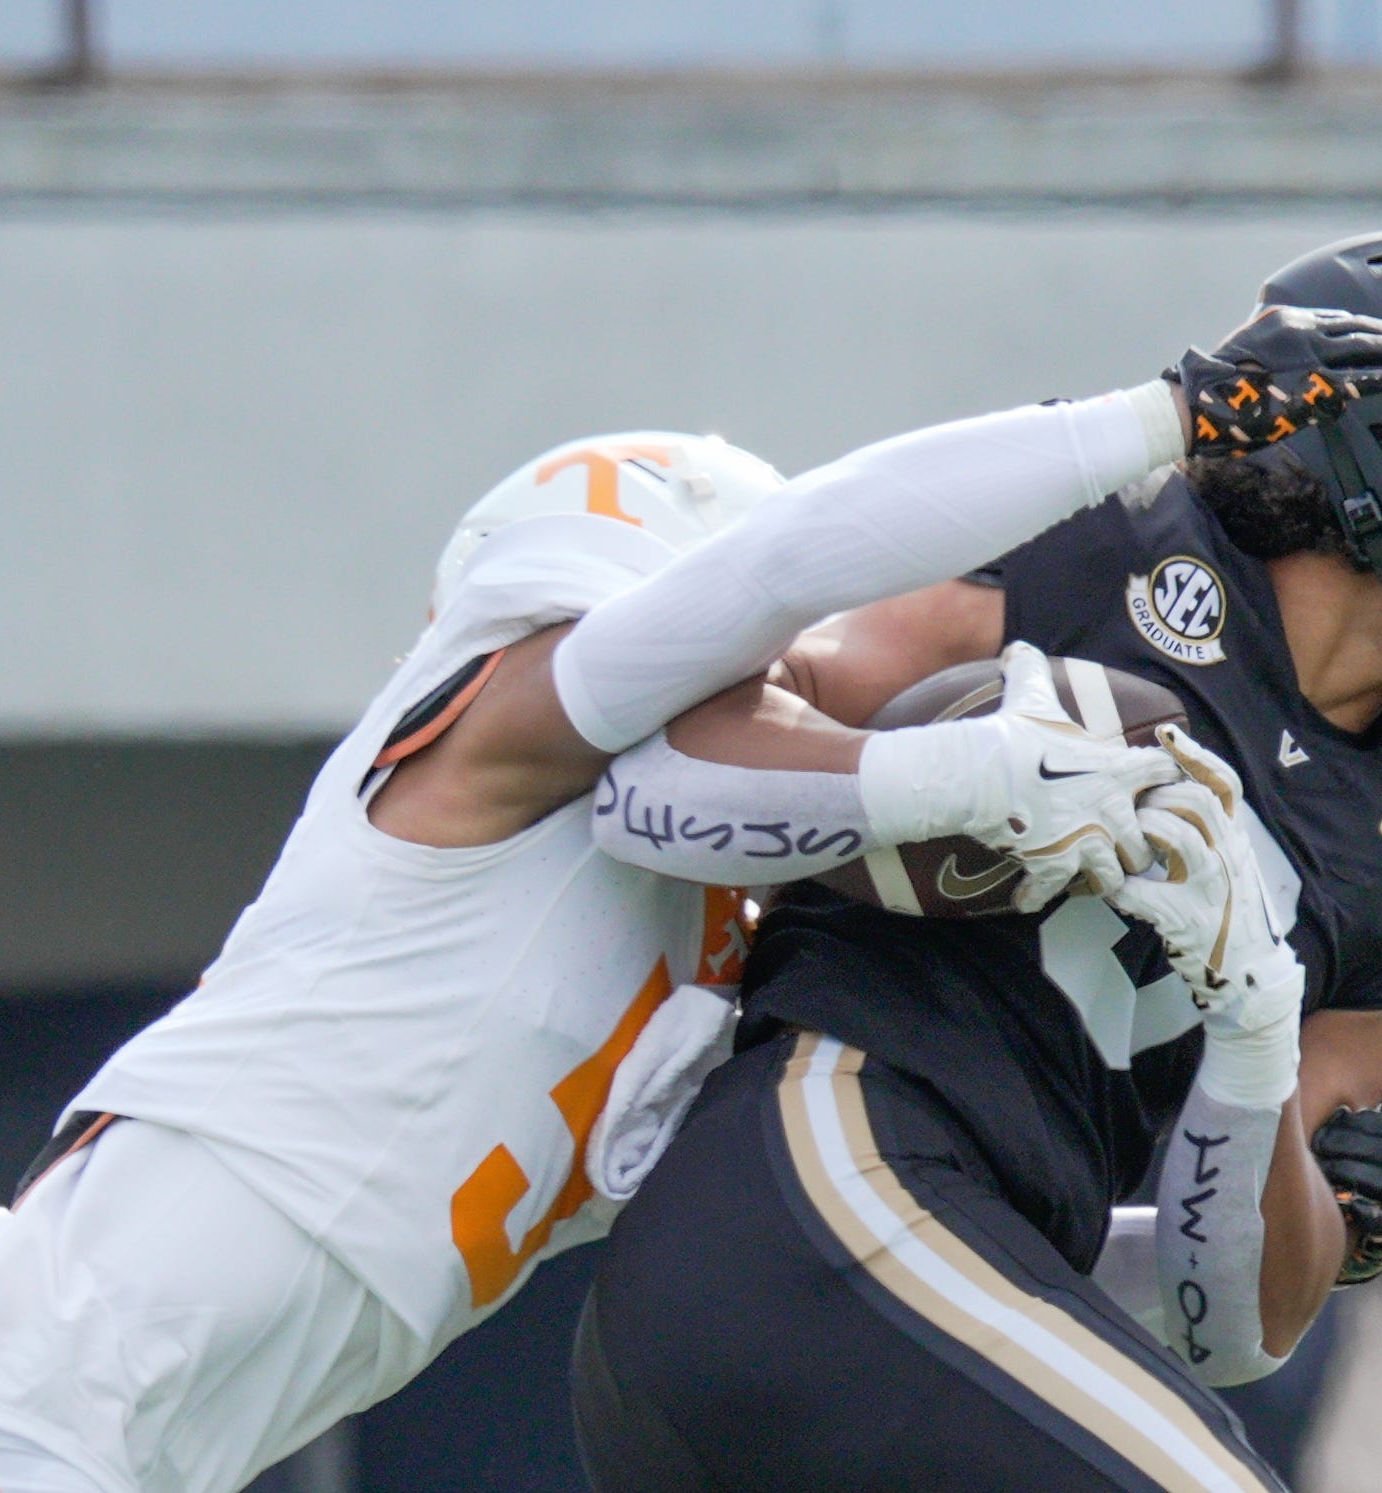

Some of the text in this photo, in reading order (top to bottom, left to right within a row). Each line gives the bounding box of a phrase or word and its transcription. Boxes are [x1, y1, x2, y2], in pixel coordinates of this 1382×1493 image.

[534, 445, 673, 527] T
[1132, 597, 1205, 660] GRADUATE
[1154, 563, 1219, 637] SEC
